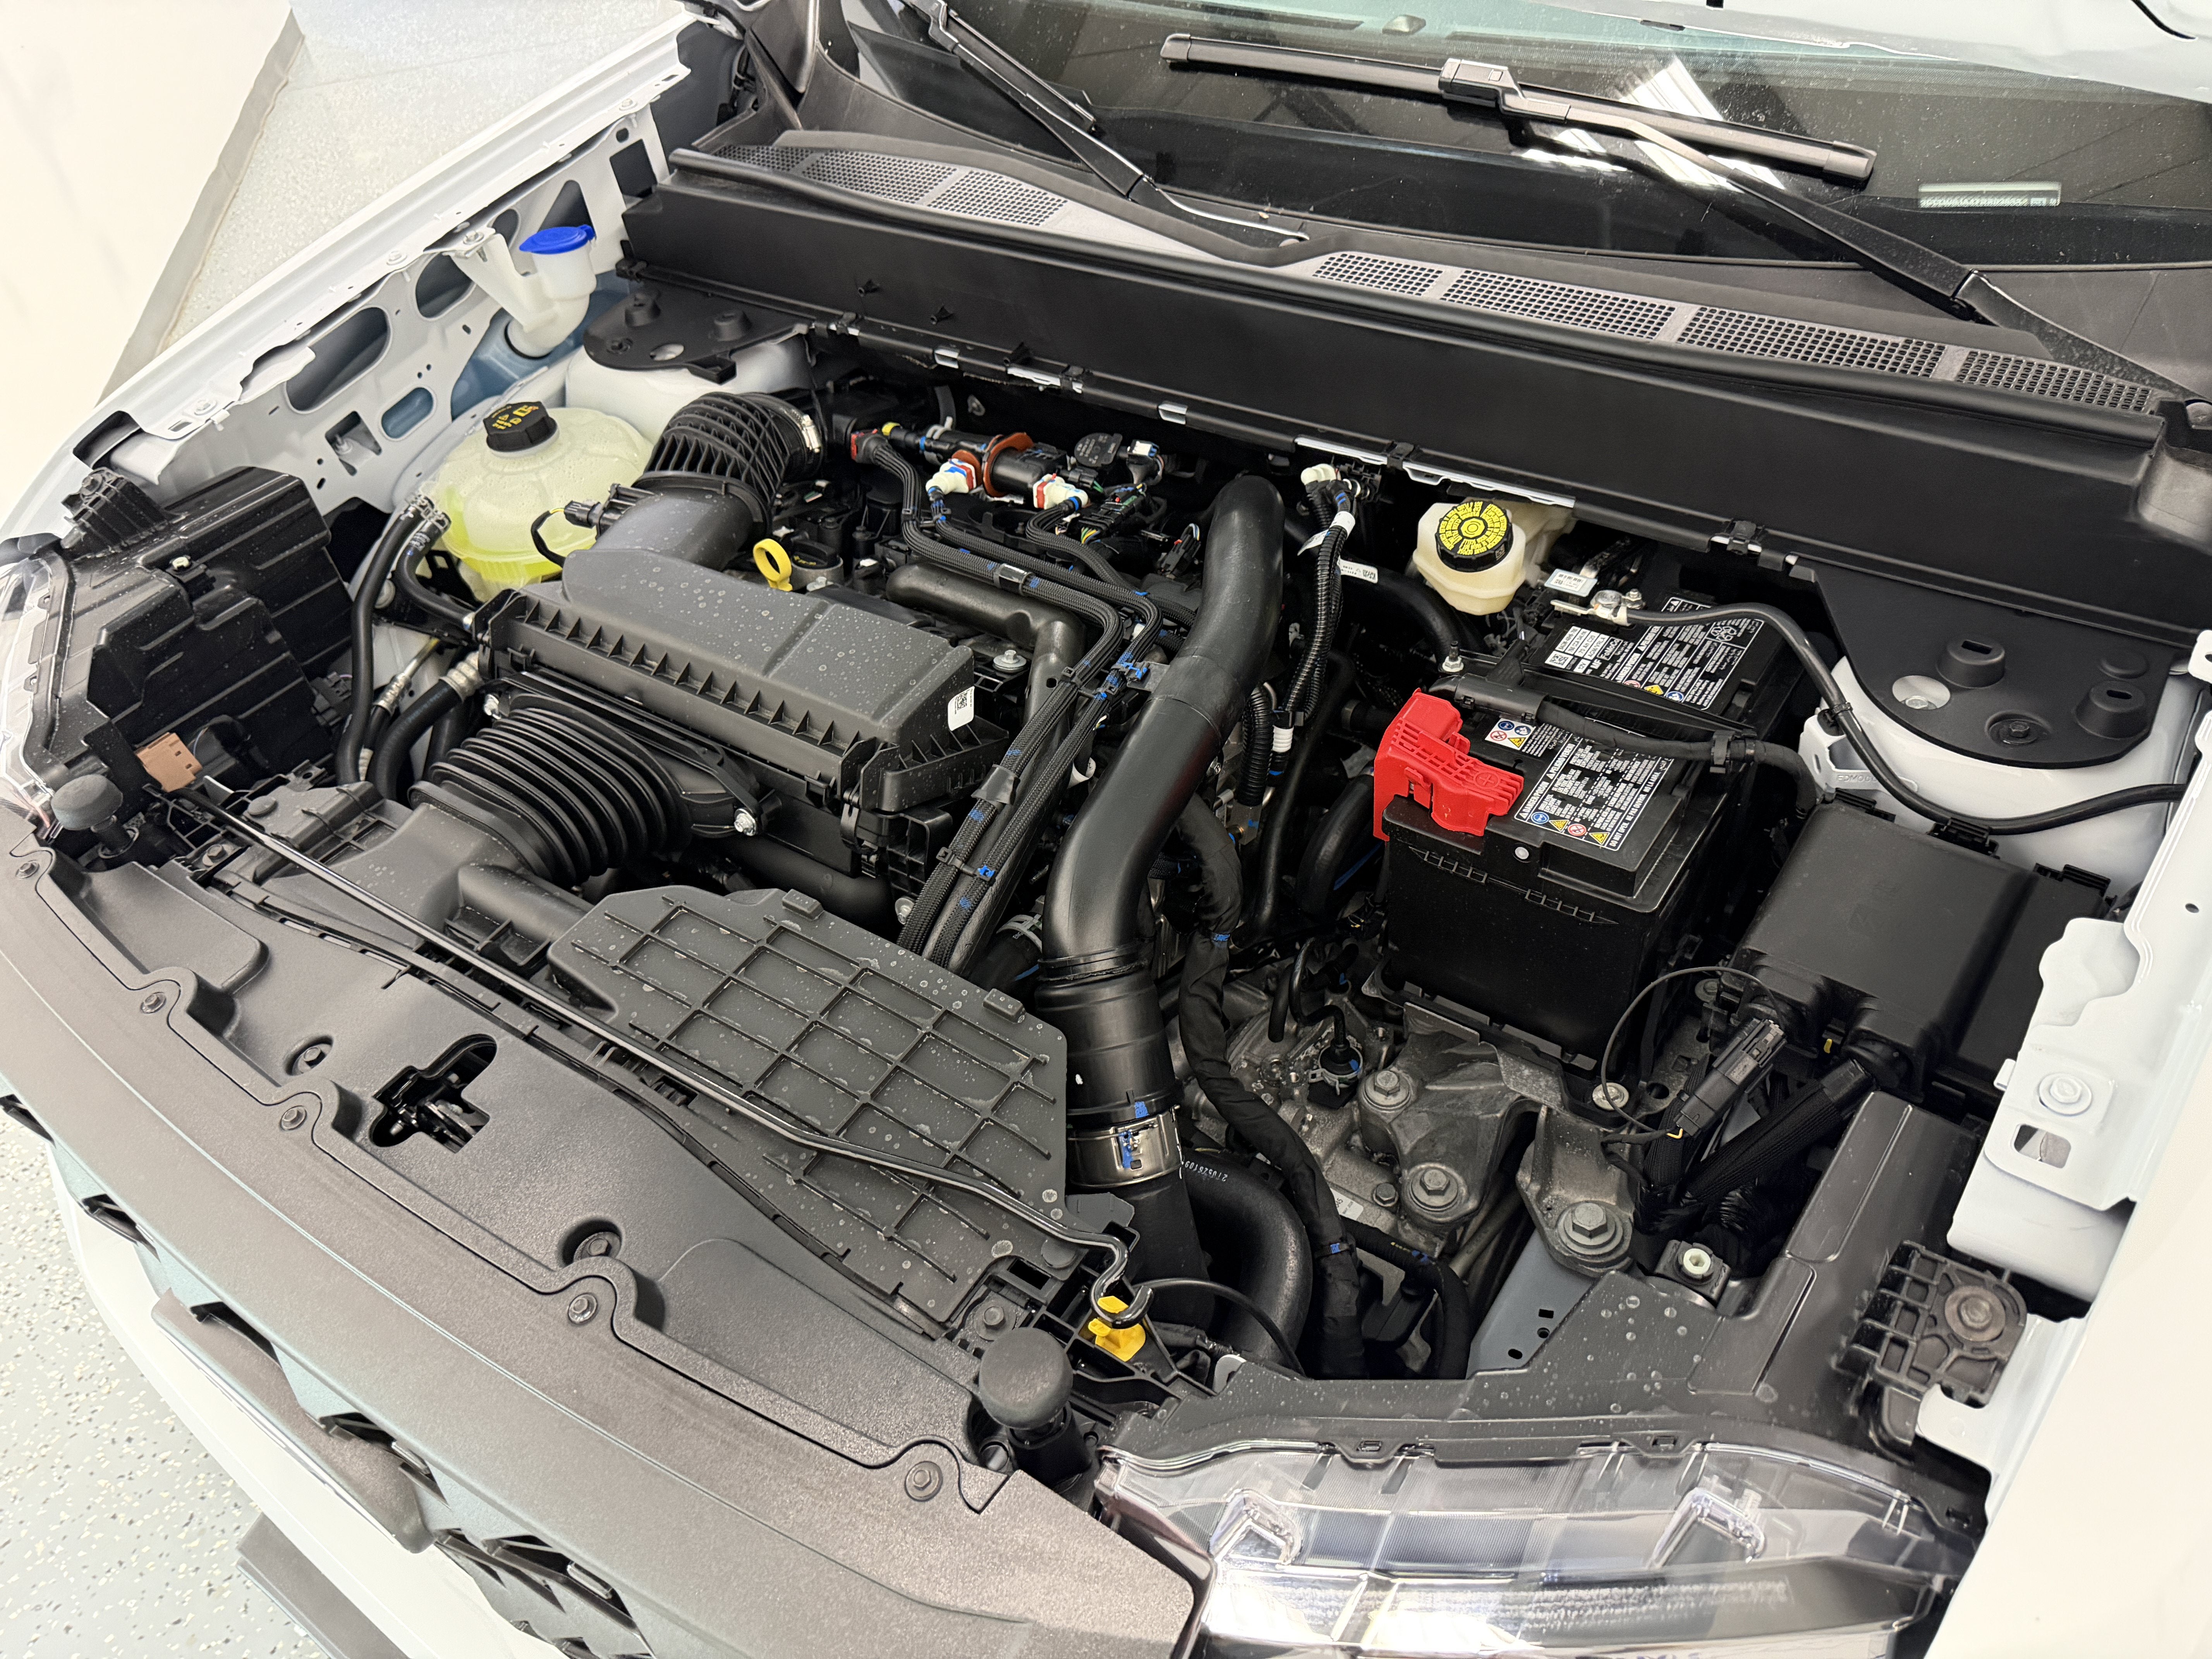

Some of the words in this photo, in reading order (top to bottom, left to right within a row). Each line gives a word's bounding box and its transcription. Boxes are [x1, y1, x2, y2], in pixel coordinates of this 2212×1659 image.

[1590, 659, 1602, 669] MF
[1601, 639, 1620, 659] FoMoCo
[1549, 742, 1575, 774] PELIGRO/VENENO
[1522, 780, 1550, 813] DANGER/POISON
[1612, 831, 1623, 841] NOT
[1628, 807, 1638, 816] PAS
